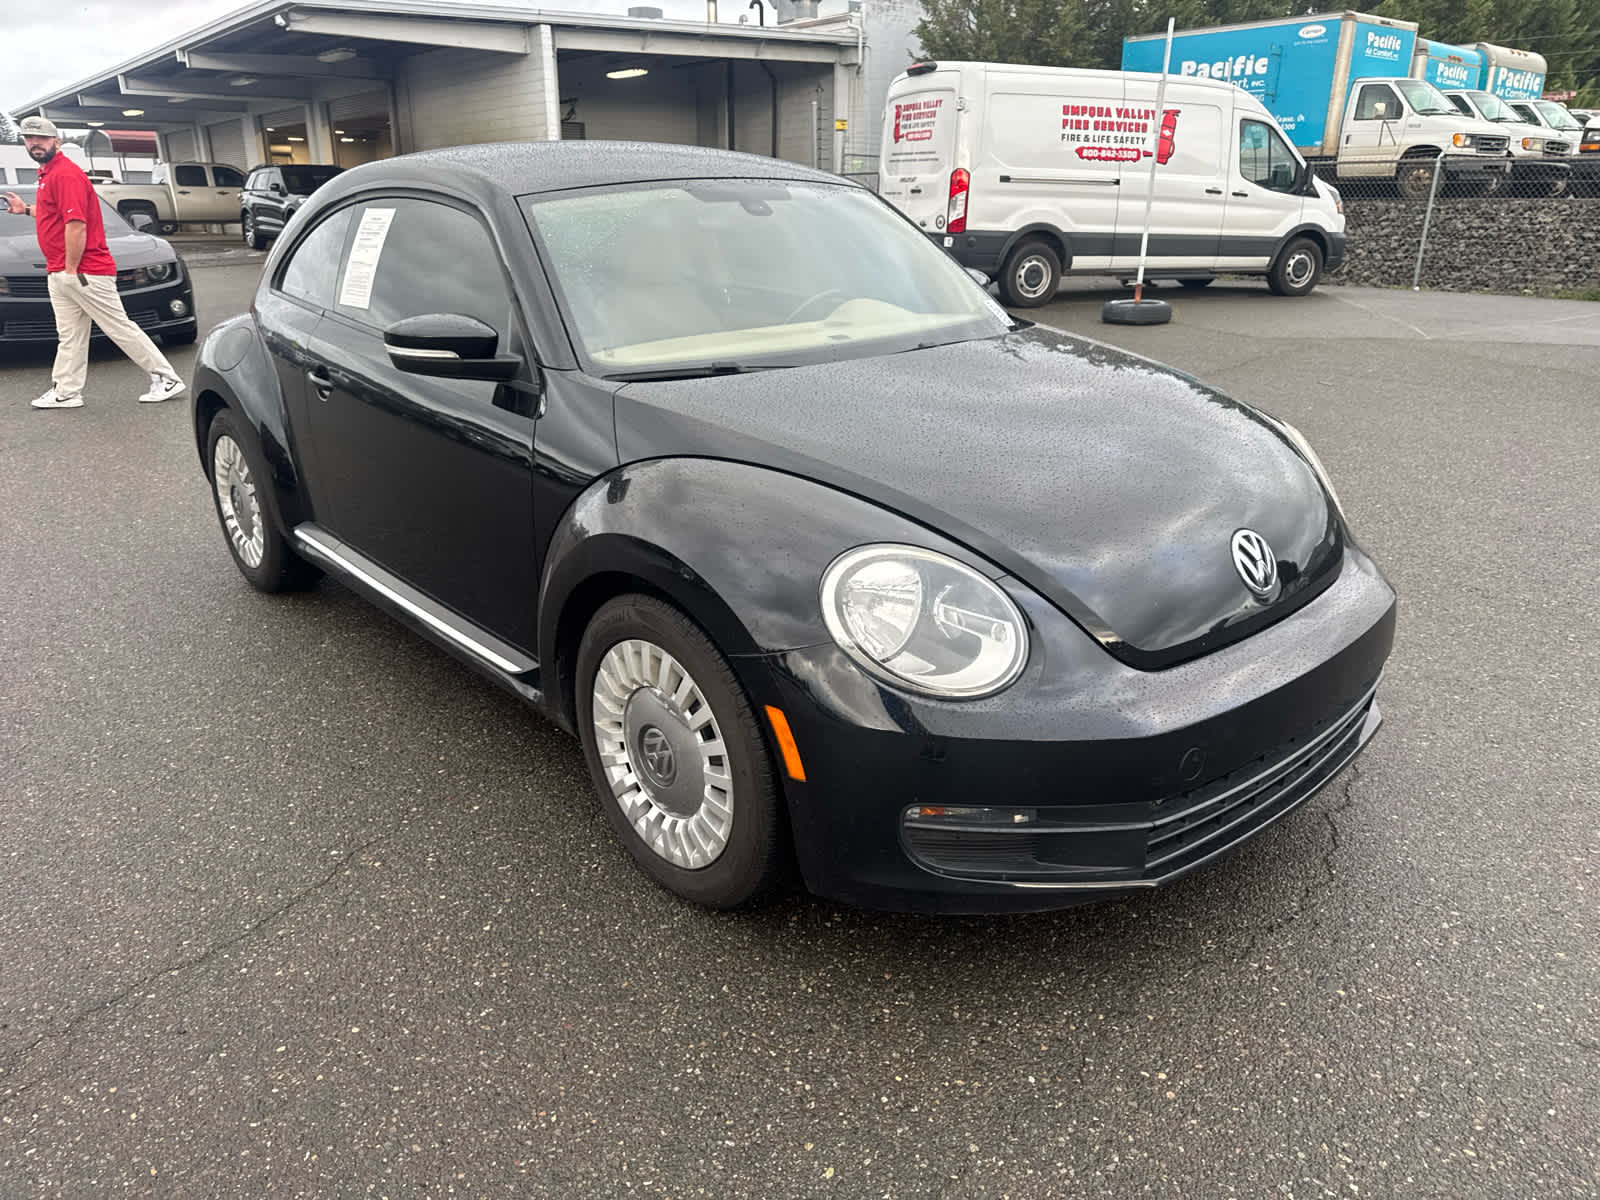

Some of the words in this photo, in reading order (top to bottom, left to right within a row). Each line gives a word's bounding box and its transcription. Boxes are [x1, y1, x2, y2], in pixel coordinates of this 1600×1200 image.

[1367, 31, 1401, 50] Pacific
[1181, 54, 1269, 78] Pacific
[1437, 62, 1468, 80] Pacific
[1497, 67, 1541, 92] Pacific
[1062, 104, 1112, 118] UMPQUA
[1062, 118, 1089, 131] FIRE
[1093, 119, 1148, 133] SERVICES
[1061, 133, 1082, 142] FIRE
[1083, 134, 1090, 142] &
[1092, 134, 1112, 143] LIFE
[1113, 135, 1147, 145] SAFETY
